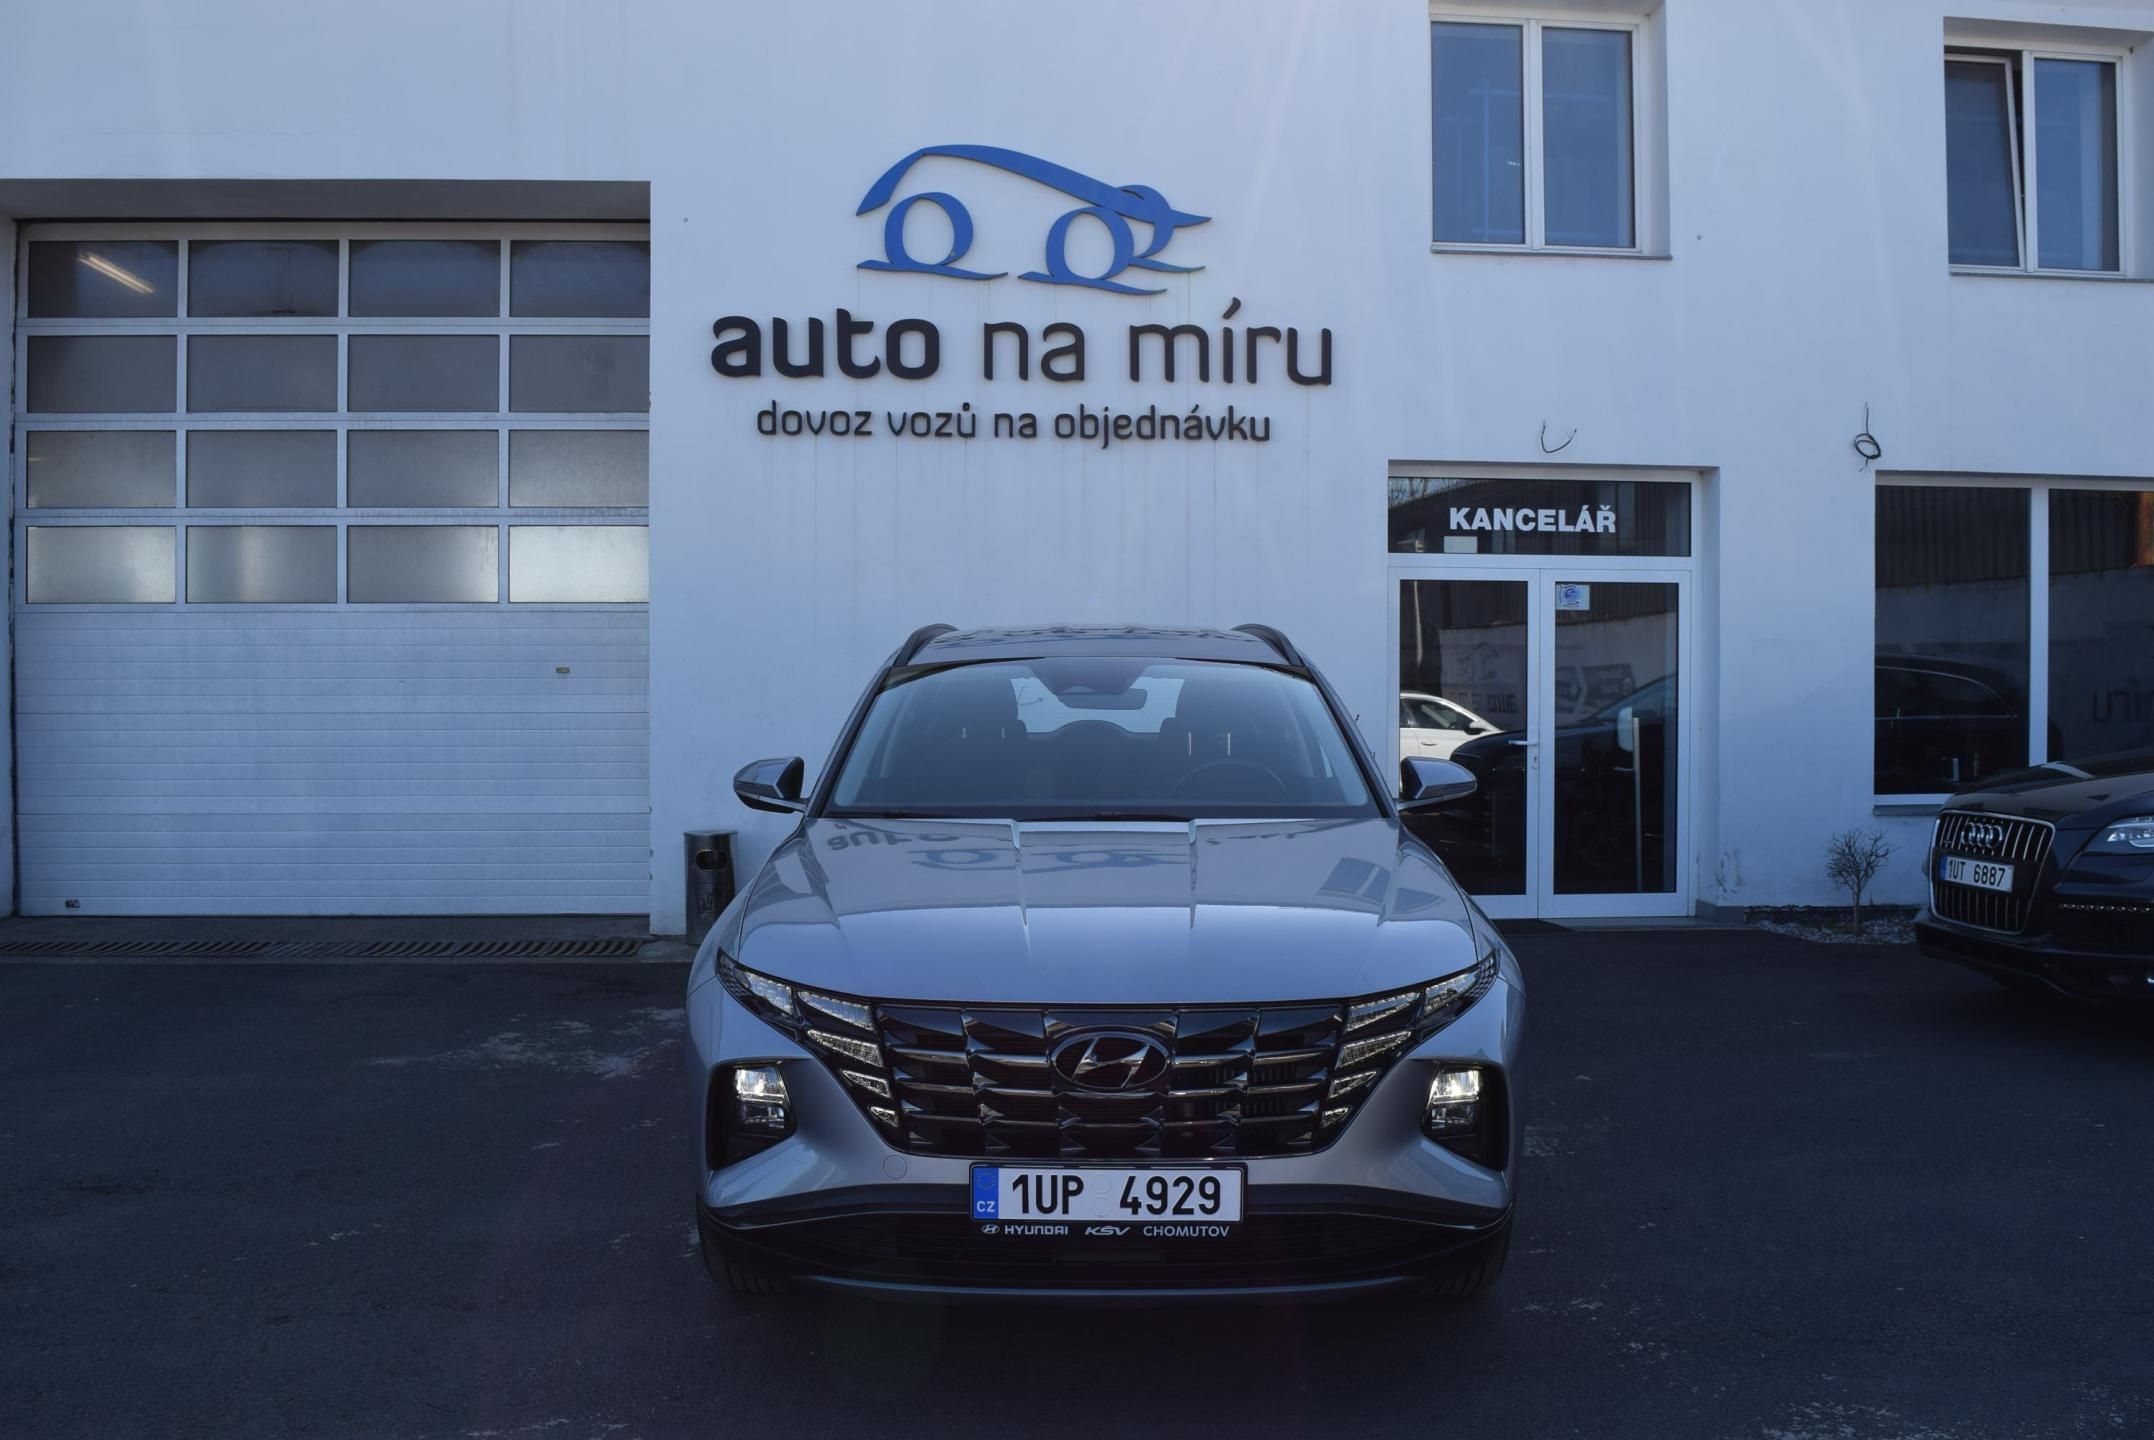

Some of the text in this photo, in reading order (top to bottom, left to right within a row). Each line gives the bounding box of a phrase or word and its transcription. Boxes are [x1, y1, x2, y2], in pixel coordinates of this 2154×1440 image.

[711, 297, 1333, 387] auto na míru
[756, 400, 1271, 450] dovoz vozů na objednávku
[1449, 504, 1617, 534] KANCELÁŘ
[1948, 859, 2006, 887] 1UT 6887
[976, 1200, 996, 1213] CZ
[1012, 1174, 1221, 1216] 1UP 4929
[1004, 1224, 1069, 1235] HYUNDAI
[1143, 1225, 1230, 1237] CHOMUTOV
